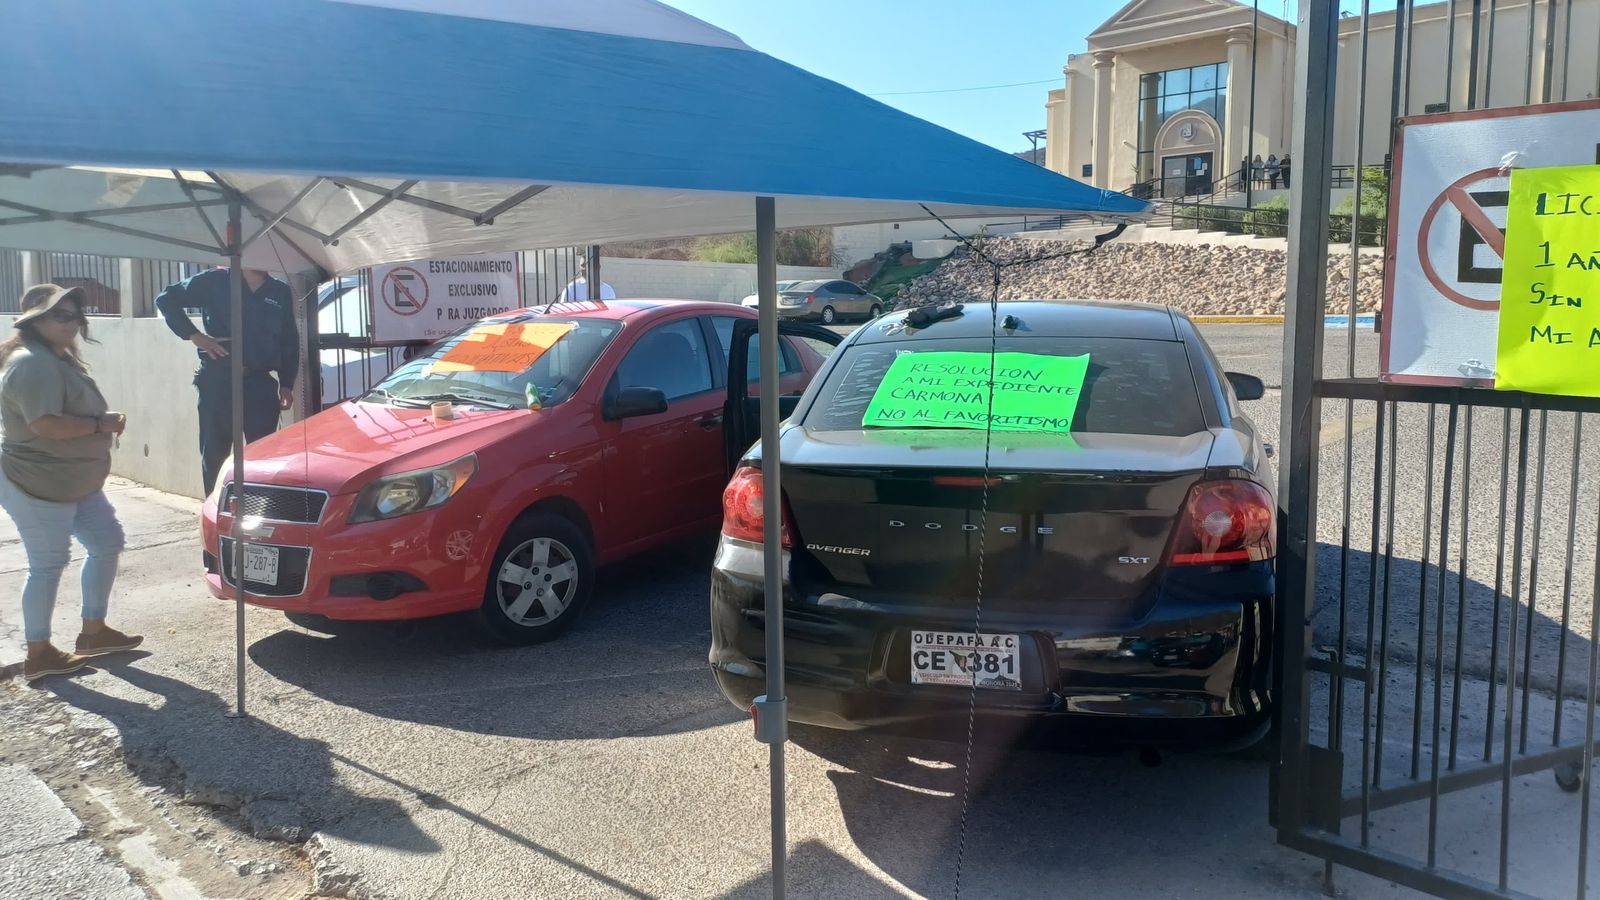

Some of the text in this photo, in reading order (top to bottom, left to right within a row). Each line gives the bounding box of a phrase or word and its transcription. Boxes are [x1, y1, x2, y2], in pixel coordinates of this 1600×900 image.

[1535, 192, 1600, 215] LIC
[1535, 241, 1555, 268] 1
[429, 261, 512, 273] ESTACIONAMIENTO
[449, 284, 497, 296] EXCLUSIVO
[1530, 325, 1573, 344] MI
[910, 363, 1043, 381] RESOLUCION
[953, 378, 1077, 396] EXPEDIENTE
[891, 388, 983, 405] CARMONA
[878, 408, 1069, 428] NO AL FAVORITISMO
[806, 543, 871, 556] AVENGER
[1118, 556, 1150, 564] SXT
[914, 633, 984, 647] ODEPAFA
[913, 650, 1013, 674] CE 381
